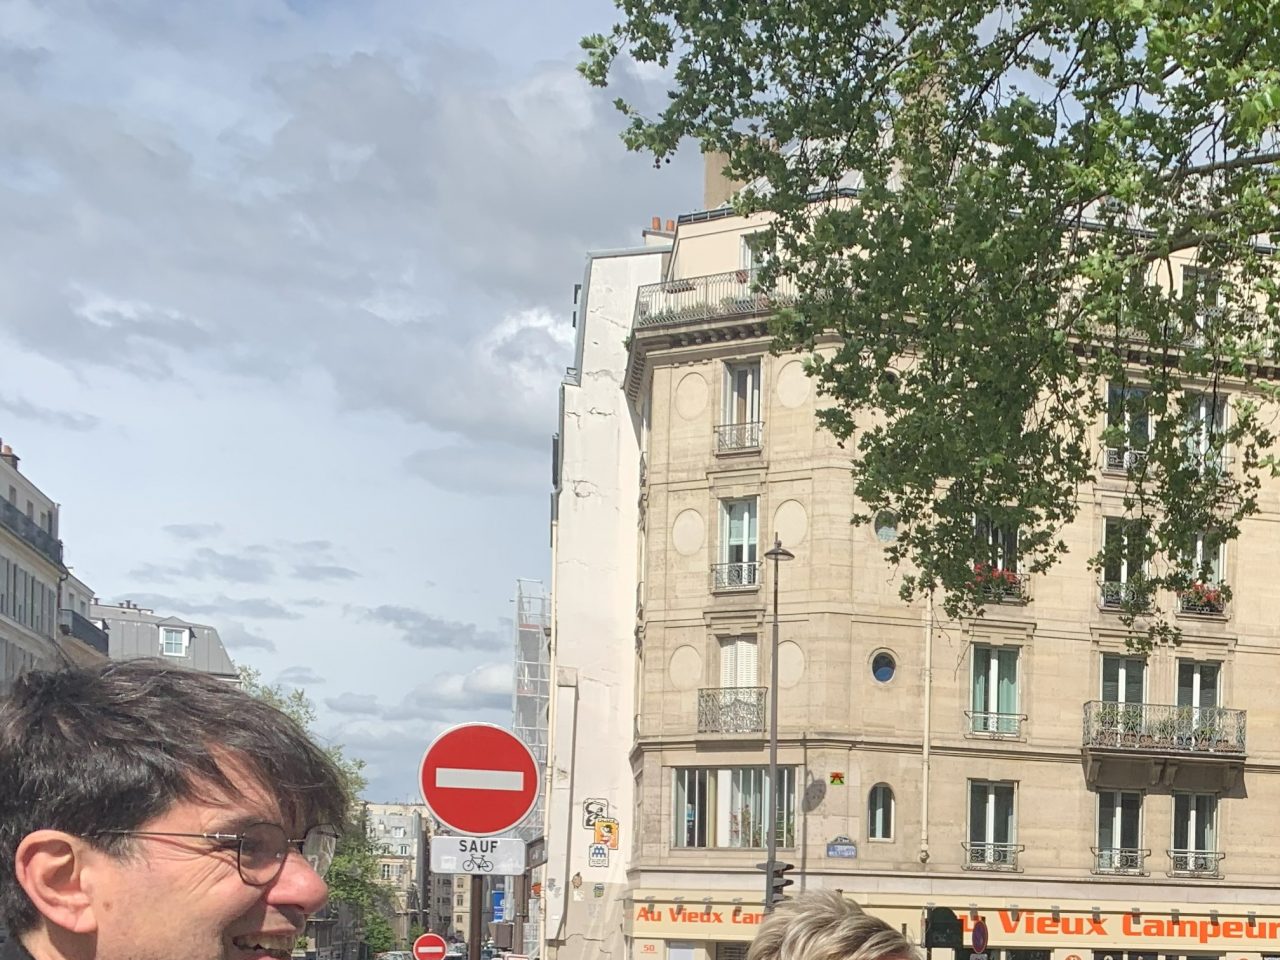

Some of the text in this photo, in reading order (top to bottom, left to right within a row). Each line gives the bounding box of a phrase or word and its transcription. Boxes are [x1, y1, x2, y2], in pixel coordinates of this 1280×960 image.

[459, 839, 499, 854] SAUF
[637, 905, 662, 922] Au
[669, 907, 724, 923] Vieux
[998, 909, 1108, 936] Vieux
[643, 944, 655, 952] 50
